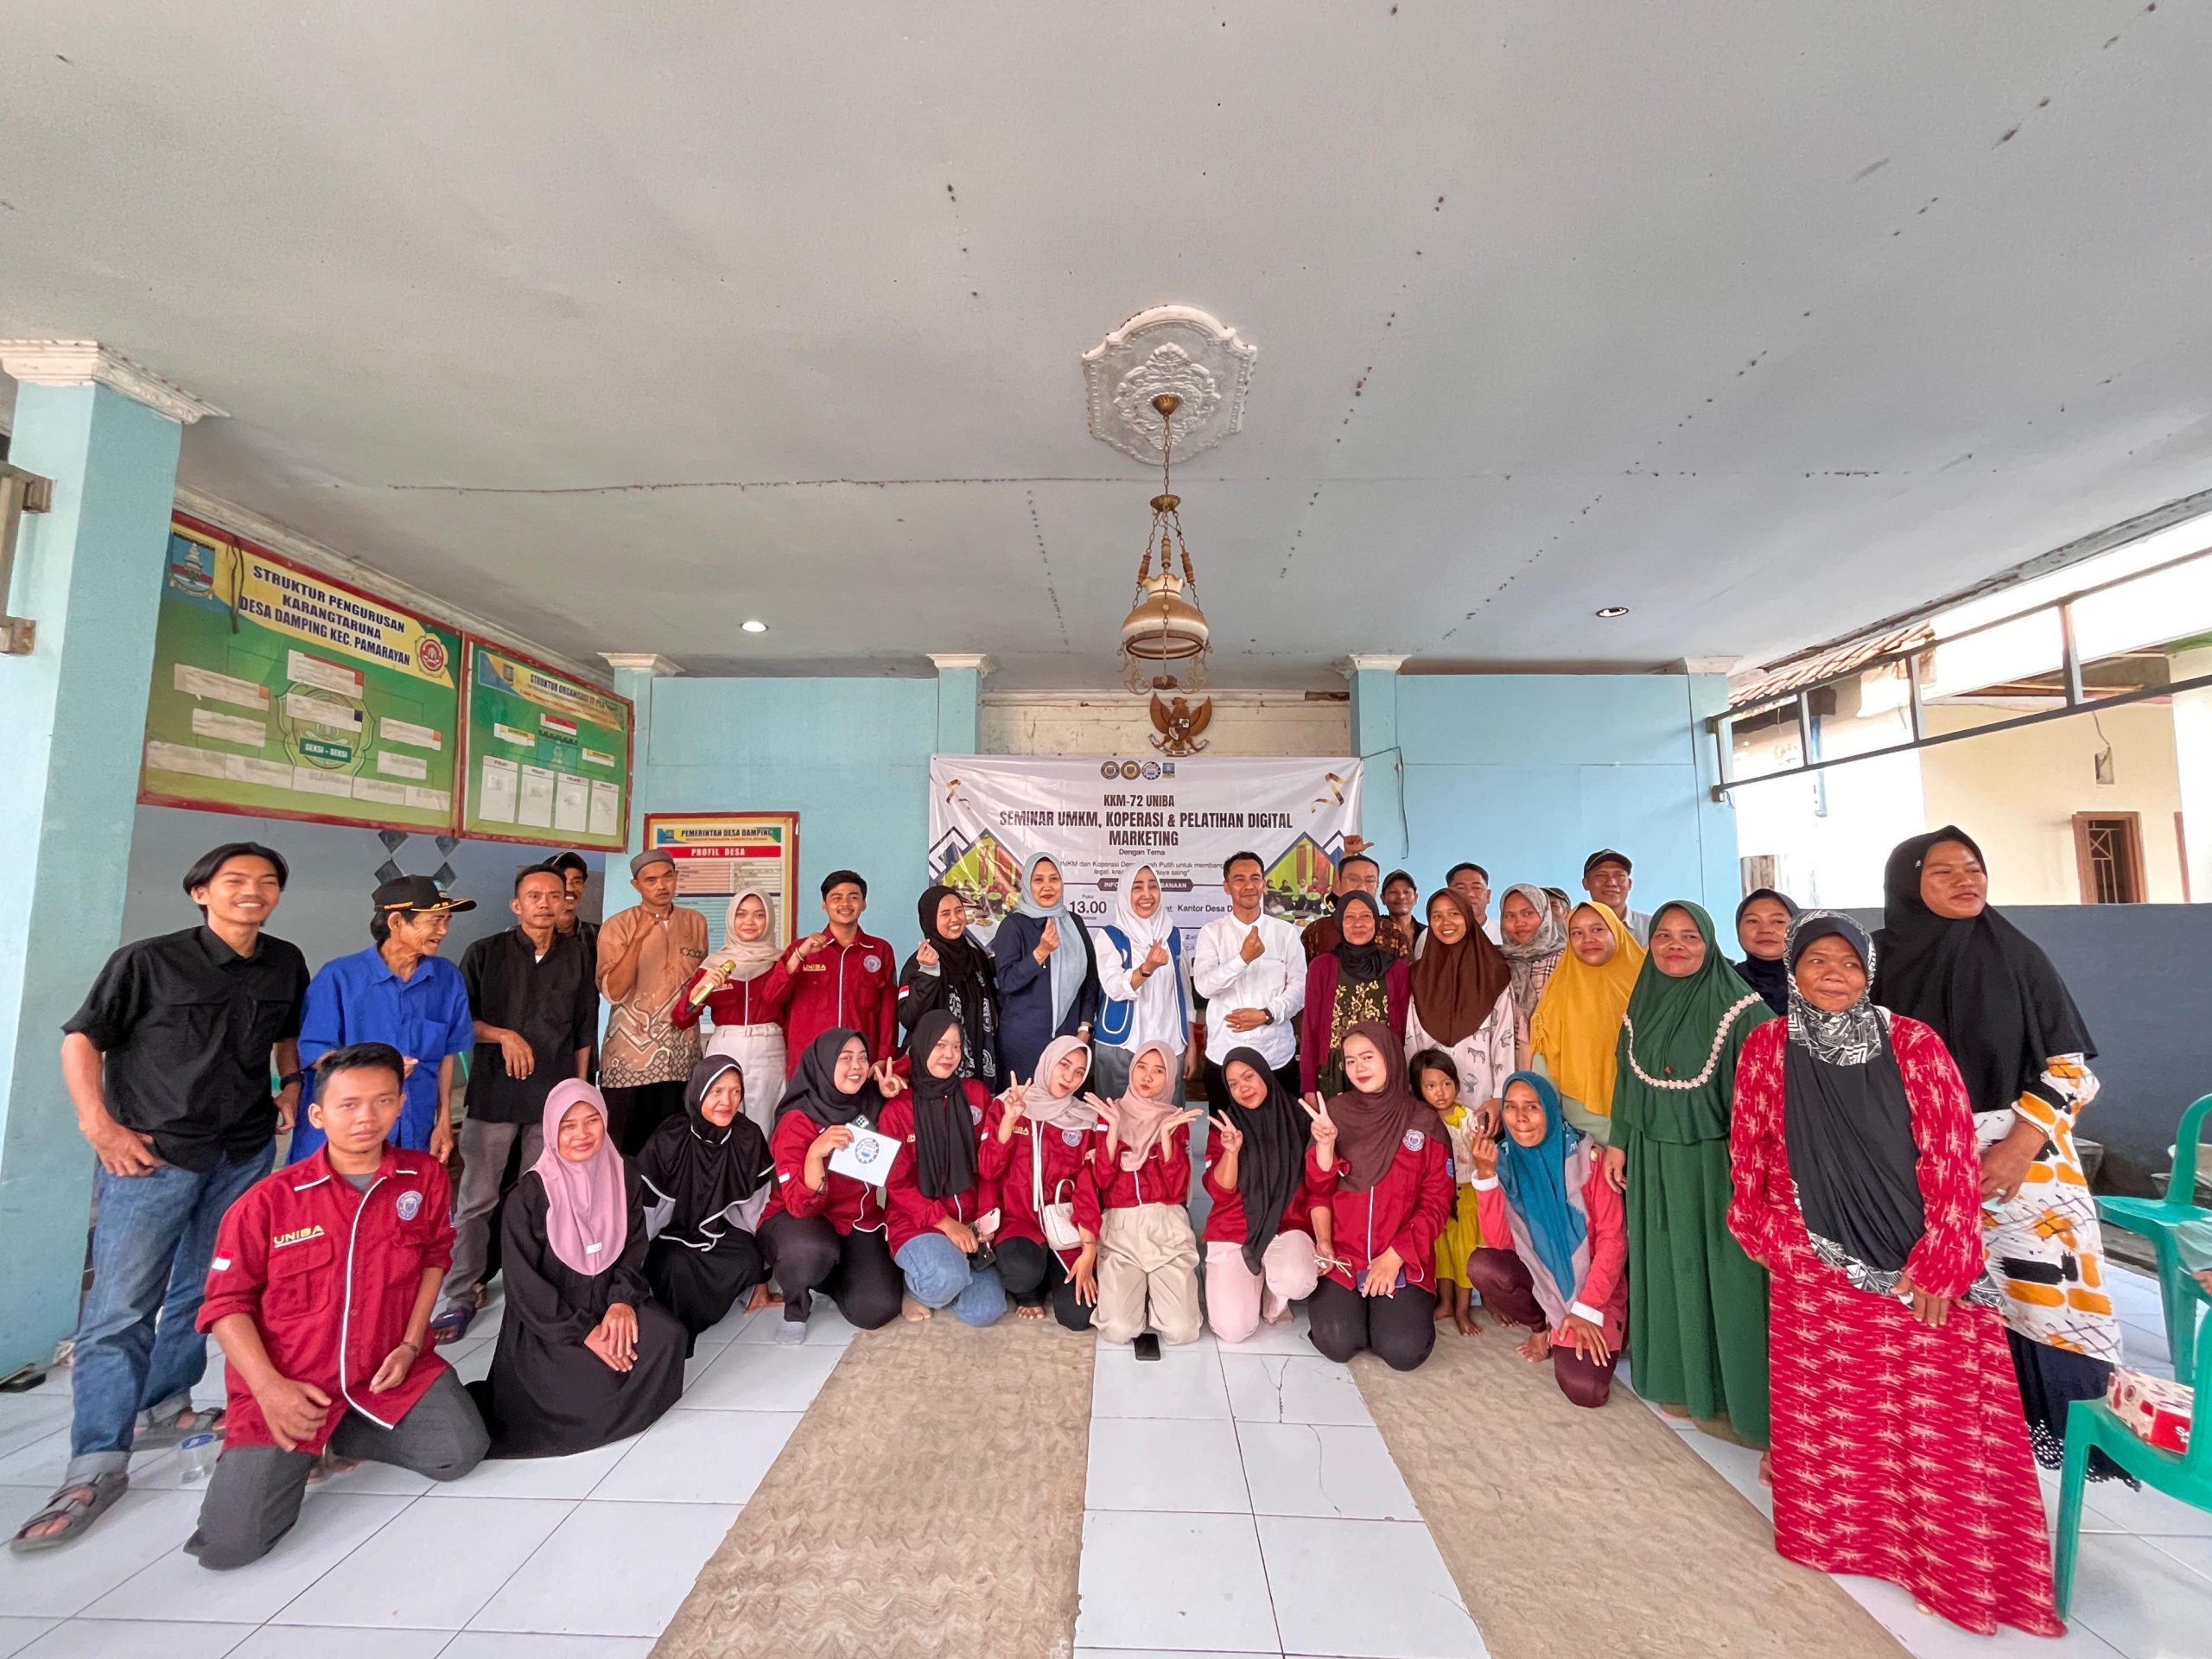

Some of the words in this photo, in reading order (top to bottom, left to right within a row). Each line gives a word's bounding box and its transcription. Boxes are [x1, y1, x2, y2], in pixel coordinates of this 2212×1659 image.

[253, 565, 325, 602] STRUKTUR
[328, 594, 405, 633] PENGURUSAN
[283, 594, 381, 640] KARANGTARUNA
[239, 596, 271, 620] DESA
[275, 608, 327, 638] DAMPING
[330, 627, 353, 647] KEC.
[354, 637, 410, 666] PAMARAYAN
[531, 674, 558, 691] STRUKTUR
[1103, 795, 1143, 807] KKM-72
[1146, 795, 1174, 807] UNIBA
[999, 810, 1054, 826] SEMINAR
[1058, 811, 1103, 829] UMKM,
[1106, 811, 1164, 827] KOPERASI
[1167, 816, 1176, 827] &
[1179, 812, 1244, 829] PELATIHAN
[1248, 813, 1293, 829] DIGITAL
[1109, 830, 1179, 846] MARKETING
[724, 848, 745, 856] DESA
[1069, 900, 1107, 914] 13.00
[273, 1224, 325, 1245] UNIBA
